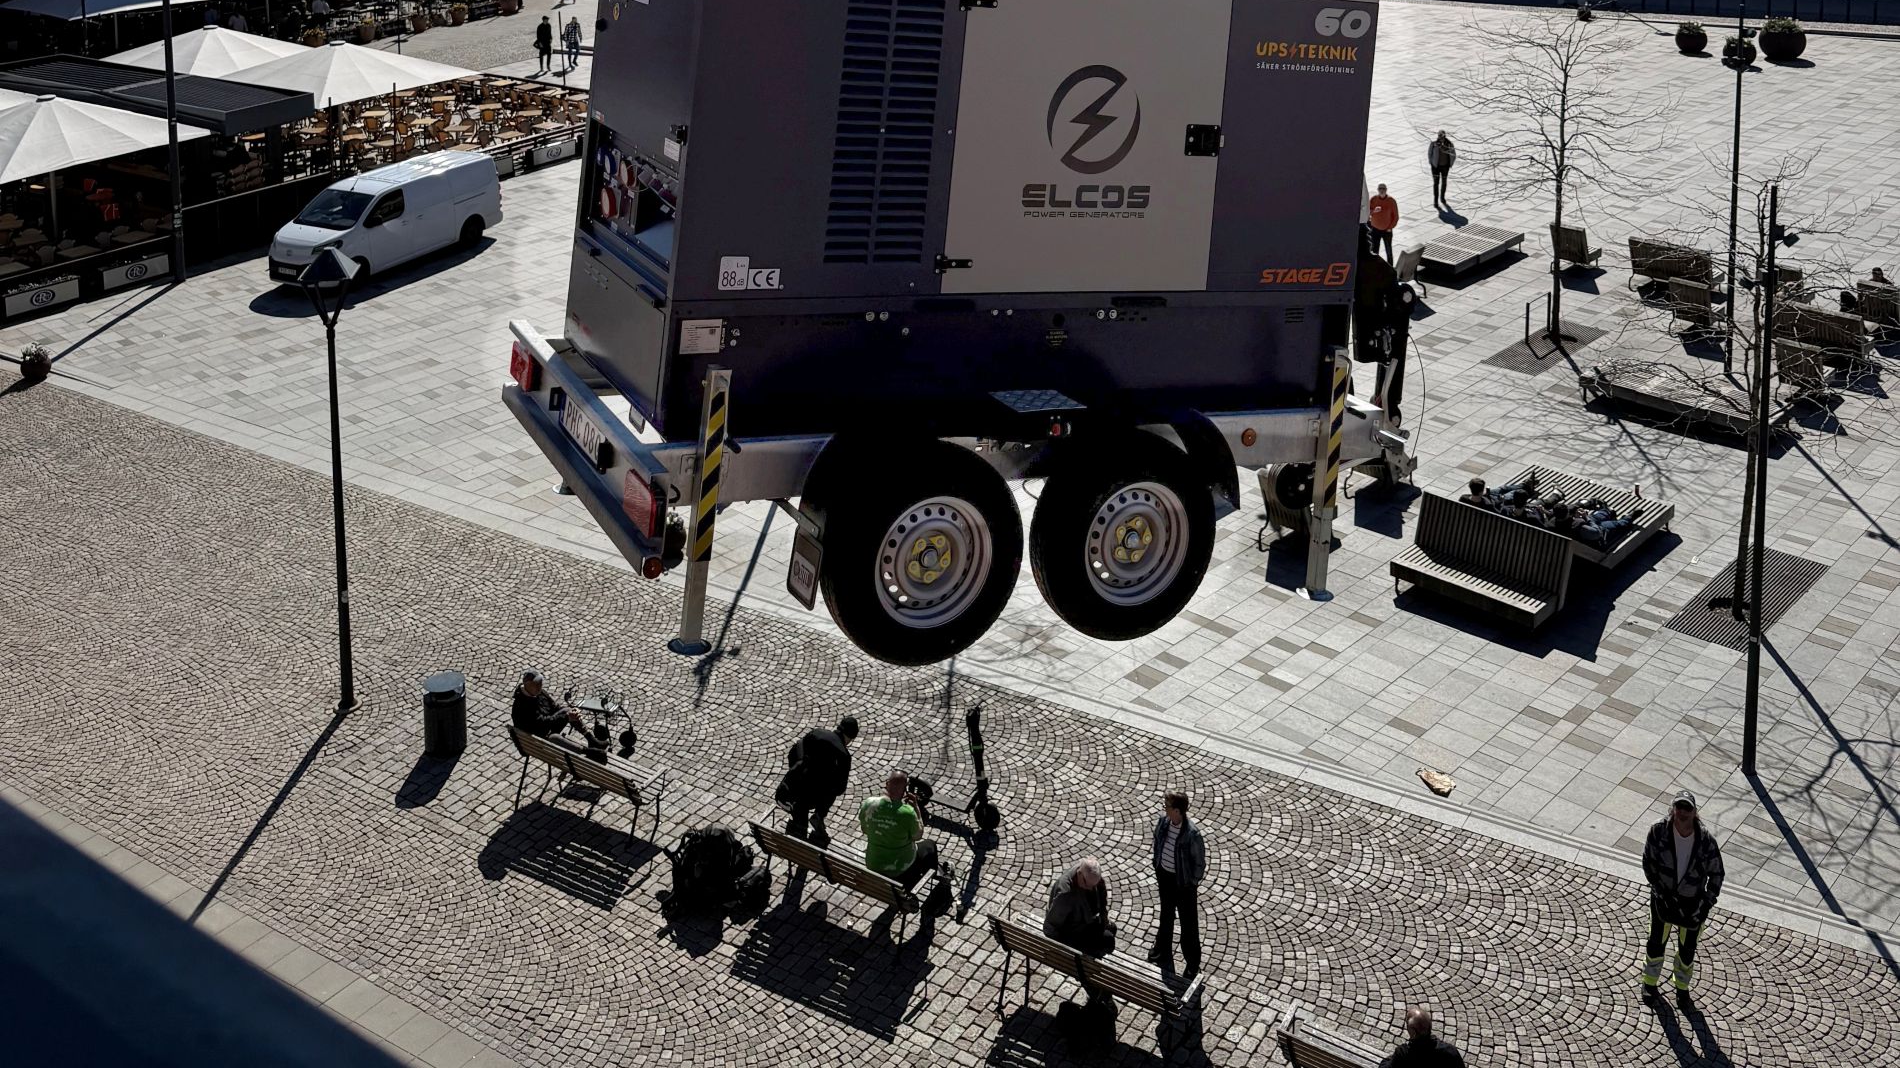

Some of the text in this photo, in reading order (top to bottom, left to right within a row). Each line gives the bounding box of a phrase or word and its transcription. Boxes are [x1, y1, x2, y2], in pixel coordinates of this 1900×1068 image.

[1315, 8, 1371, 38] 60
[1256, 41, 1359, 61] UPS TEKNIK
[1022, 184, 1151, 209] ELCOS
[1069, 211, 1145, 219] GENERATORS
[721, 270, 737, 287] 88
[752, 270, 776, 287] CE
[1259, 268, 1324, 284] STAGE
[565, 401, 583, 439] PHC
